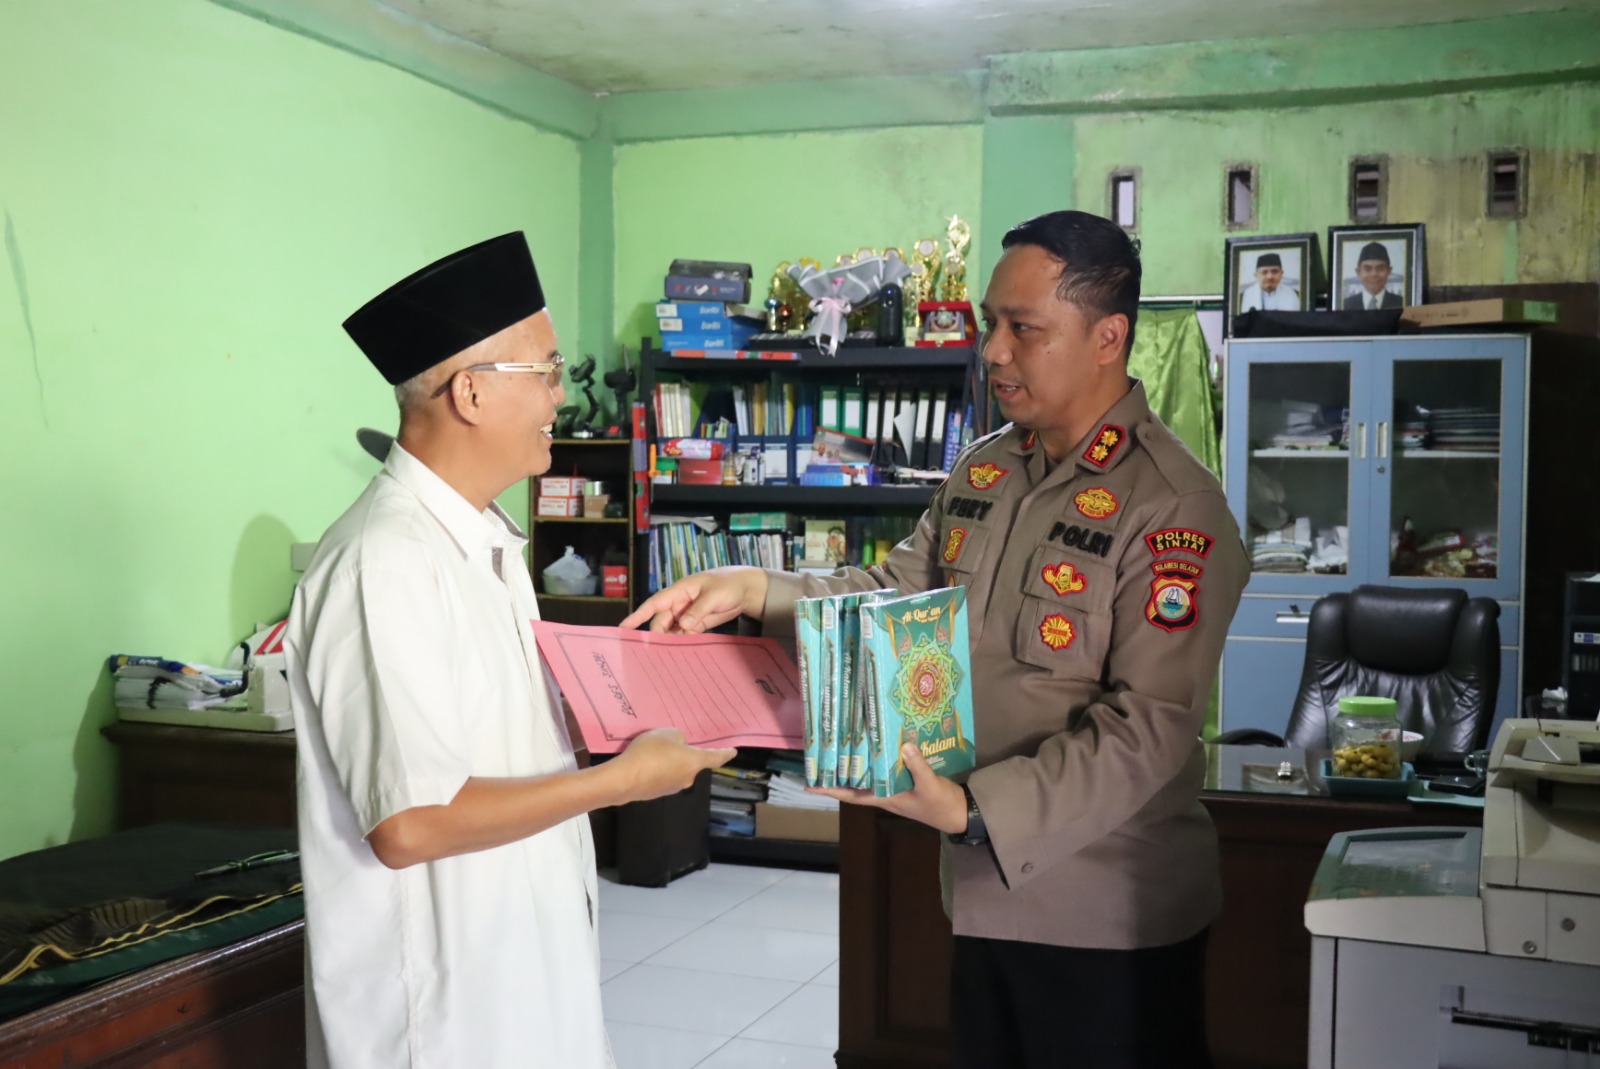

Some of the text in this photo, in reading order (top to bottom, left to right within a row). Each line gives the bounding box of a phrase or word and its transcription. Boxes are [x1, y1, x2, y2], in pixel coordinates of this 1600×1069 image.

[1047, 521, 1115, 558] POLRI
[1156, 531, 1205, 546] POLRES
[1156, 539, 1204, 553] SINJAI
[843, 652, 852, 698] Al-Kalam
[920, 736, 956, 757] Kalam
